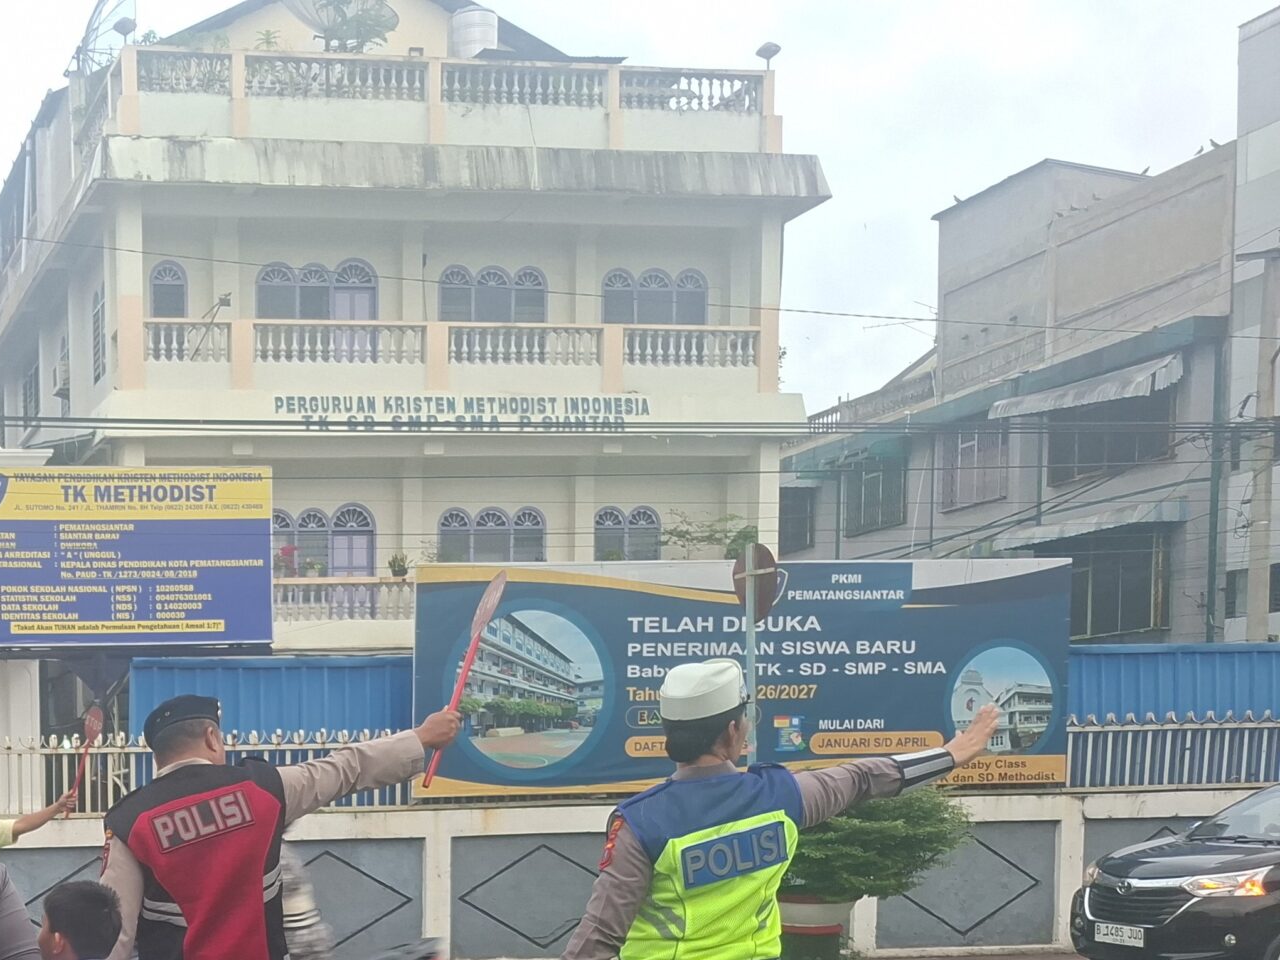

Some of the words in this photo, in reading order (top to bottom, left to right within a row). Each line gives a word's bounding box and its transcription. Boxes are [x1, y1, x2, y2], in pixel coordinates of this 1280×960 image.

[275, 396, 376, 414] PERGURUAN
[383, 397, 455, 414] KRISTEN
[463, 397, 557, 415] METHODIST
[564, 397, 650, 416] INDONESIA
[61, 485, 87, 503] TK
[94, 485, 217, 502] METHODIST
[59, 523, 135, 531] PEMATANGSIANTAR
[118, 560, 167, 568] PENDIDIKAN
[190, 559, 264, 567] PEMATANGSIANTAR
[831, 574, 862, 584] PKMI
[787, 590, 904, 600] PEMATANGSIANTAR
[628, 616, 714, 633] TELAH
[781, 641, 849, 655] SISWA
[856, 640, 916, 655] BARU
[756, 664, 781, 675] TK
[799, 663, 826, 675] SD
[844, 662, 887, 675] SMP
[903, 662, 947, 675] SMA
[757, 685, 818, 699] 26/2027
[819, 719, 854, 729] MULAI
[857, 719, 884, 729] DARI
[818, 738, 870, 749] JANUARI
[874, 737, 893, 748] S/D
[897, 737, 930, 747] APRIL
[995, 758, 1027, 769] Class
[952, 773, 974, 783] dan
[978, 773, 995, 782] SD
[998, 771, 1056, 782] Methodist
[152, 790, 251, 849] POLISI
[685, 826, 786, 884] POLISI
